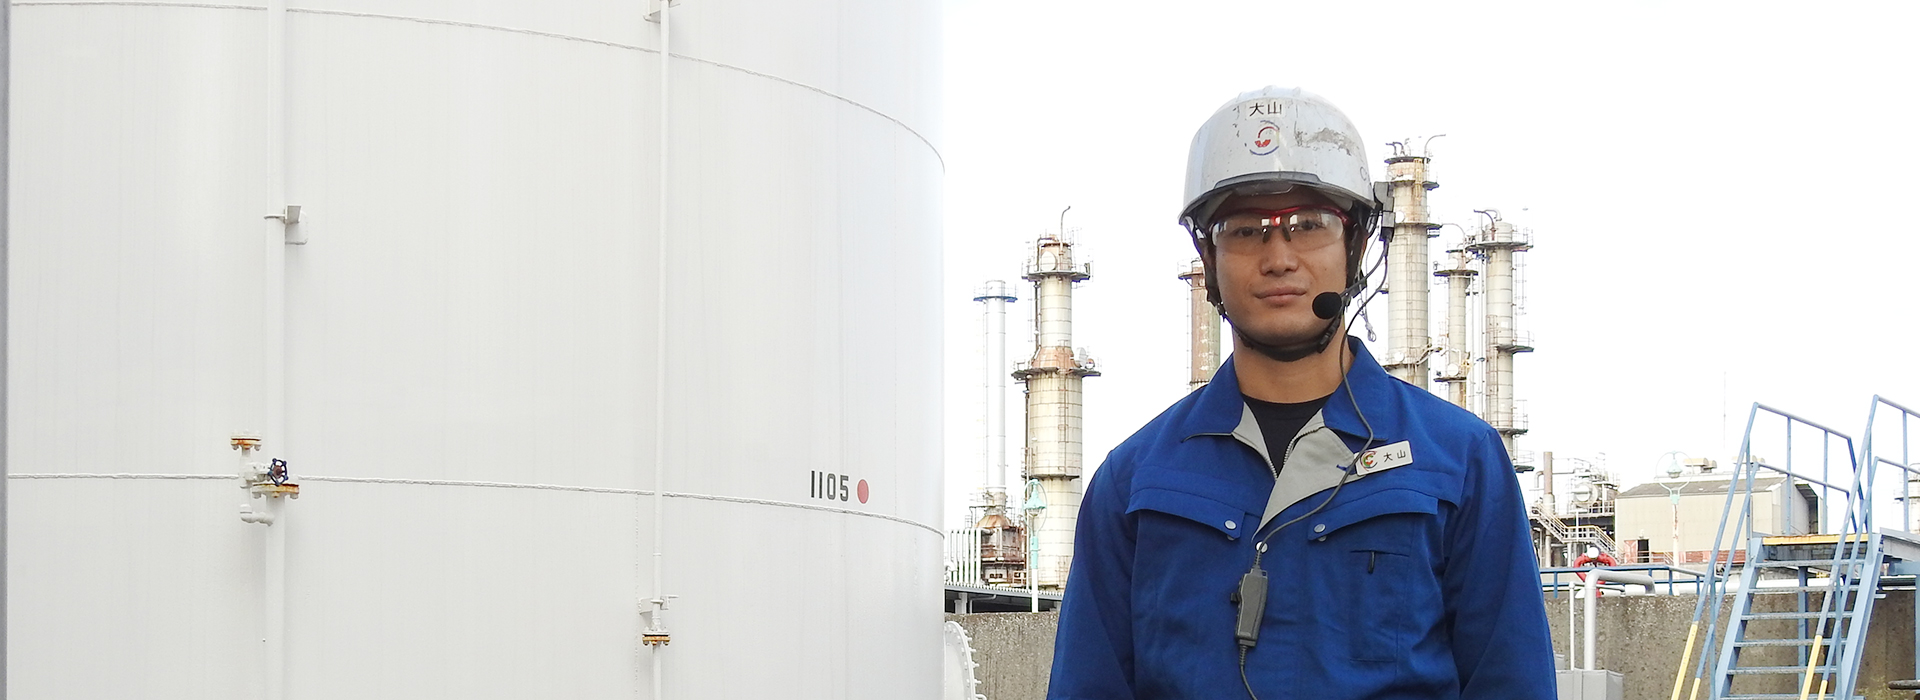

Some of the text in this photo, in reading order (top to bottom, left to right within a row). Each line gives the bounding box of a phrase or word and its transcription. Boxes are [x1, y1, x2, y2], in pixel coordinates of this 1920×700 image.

[1249, 101, 1282, 117] 大山
[1383, 449, 1406, 463] 大山
[811, 470, 849, 502] 1105
